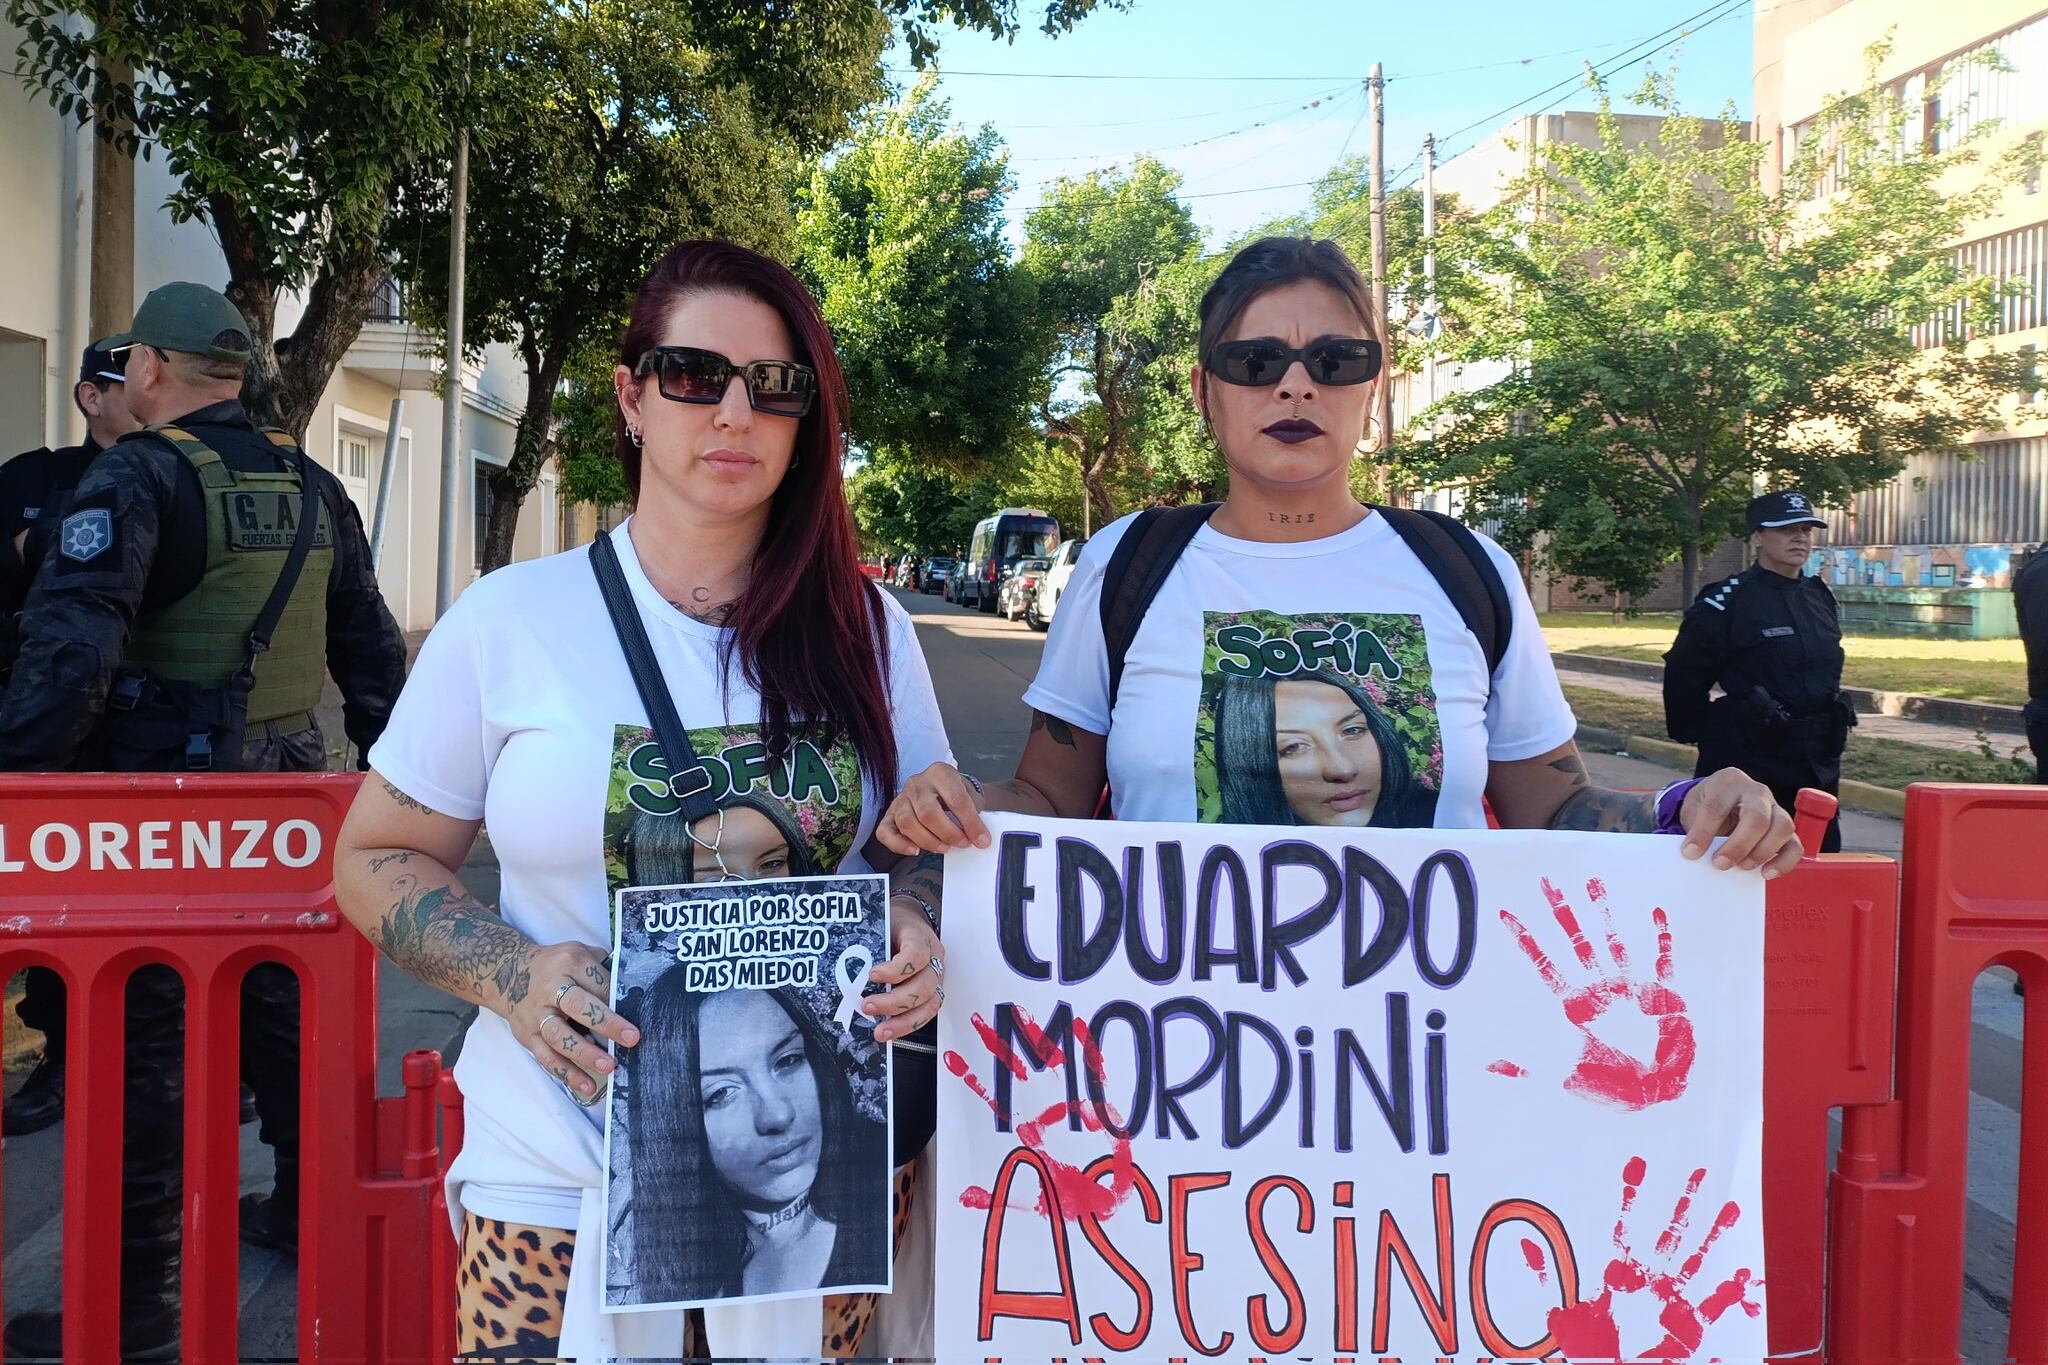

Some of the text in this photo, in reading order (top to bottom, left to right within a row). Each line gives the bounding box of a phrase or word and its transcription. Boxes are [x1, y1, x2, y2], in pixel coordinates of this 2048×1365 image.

[1267, 511, 1316, 524] IRIE
[241, 533, 281, 545] FUERZAS
[0, 818, 322, 873] LORENZO
[648, 895, 858, 929] JUSTICIA POR SOFIA
[995, 830, 1478, 992] EDUARDO
[681, 928, 825, 959] SAN LORENZO
[689, 960, 814, 989] DAS MIEDO!
